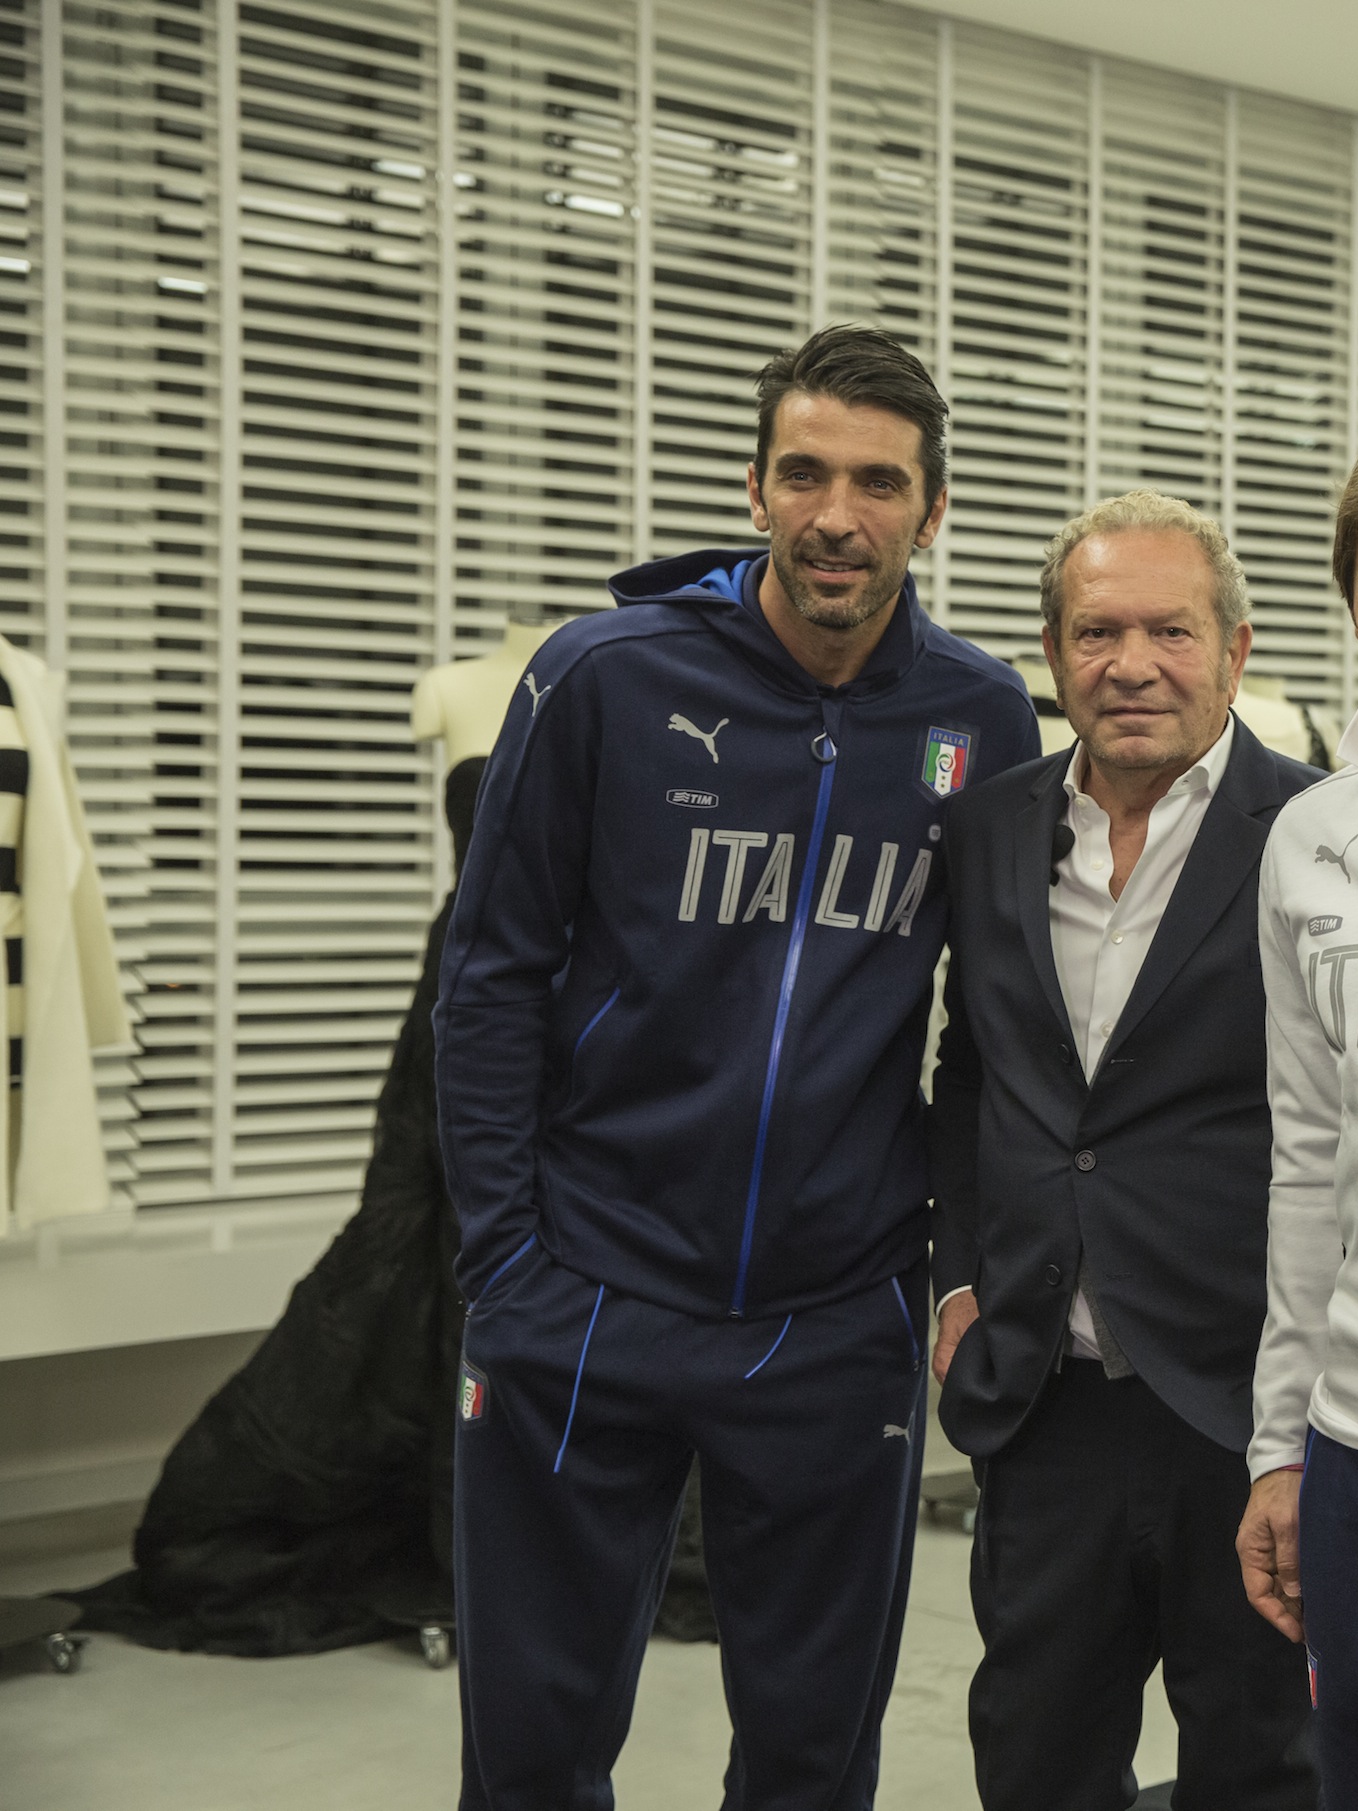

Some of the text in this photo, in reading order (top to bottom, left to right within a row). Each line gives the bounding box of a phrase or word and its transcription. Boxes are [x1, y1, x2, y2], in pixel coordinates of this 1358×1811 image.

[933, 732, 964, 746] ITALIA
[690, 794, 713, 806] TIM
[677, 827, 933, 937] ITALIA
[1320, 918, 1338, 931] TIM
